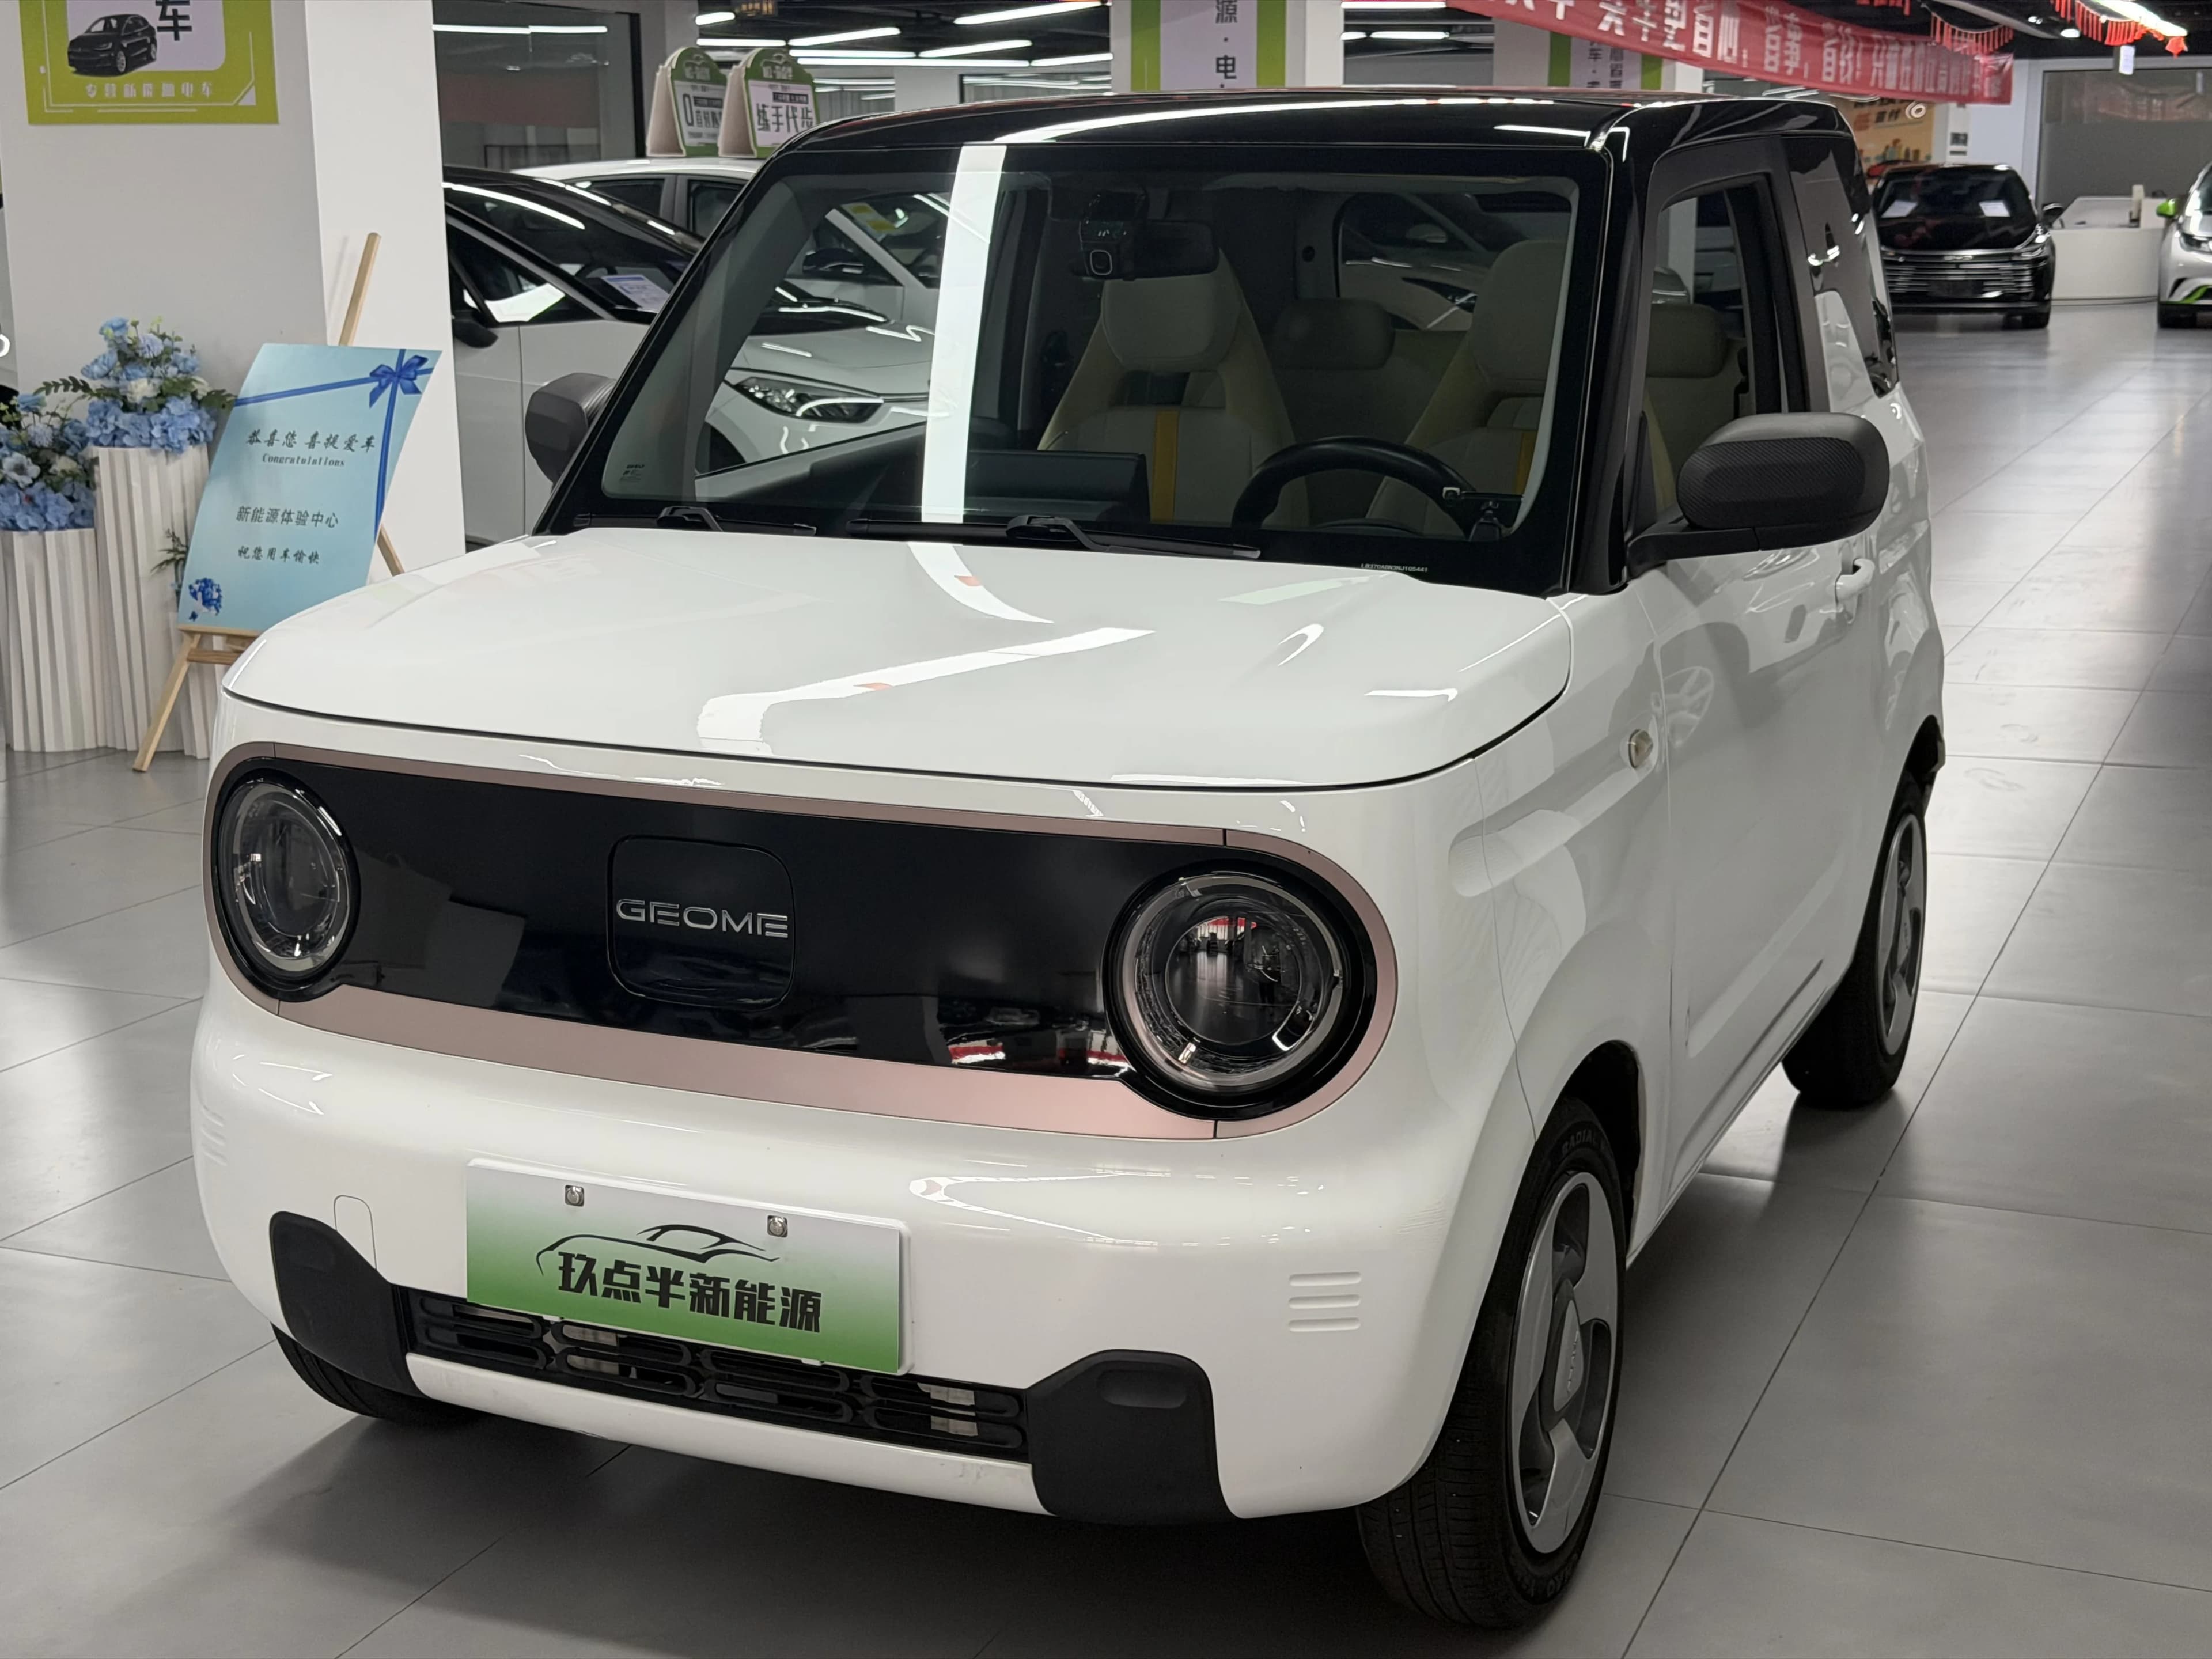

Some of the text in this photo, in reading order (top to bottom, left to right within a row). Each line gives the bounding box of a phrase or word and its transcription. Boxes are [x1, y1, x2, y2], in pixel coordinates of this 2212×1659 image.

[155, 0, 192, 41] 车
[246, 428, 297, 448] 恭喜您
[262, 453, 345, 467] Congratulations
[236, 505, 339, 528] 新能源体验中心
[238, 545, 320, 565] 祝您用车愉快
[616, 899, 788, 938] GEOME
[558, 1251, 821, 1333] 玖点半新能源
